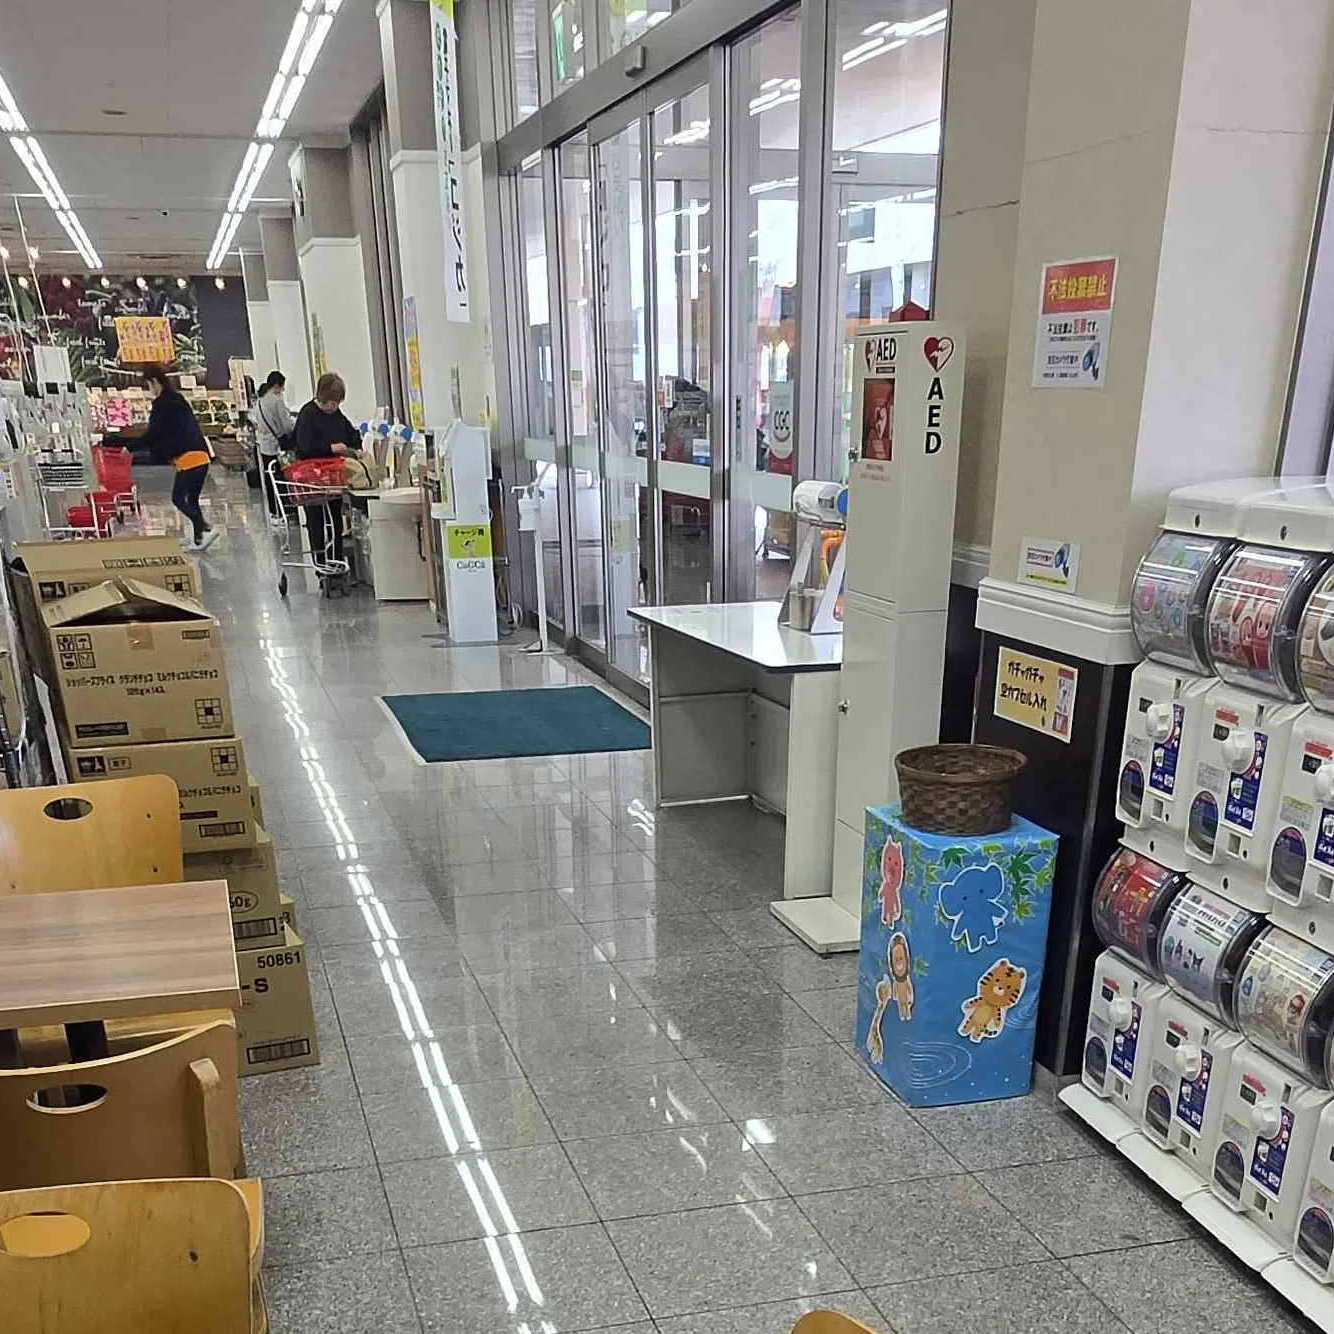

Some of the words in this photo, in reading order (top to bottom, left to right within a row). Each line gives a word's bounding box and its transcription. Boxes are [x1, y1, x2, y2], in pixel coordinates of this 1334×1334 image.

[876, 337, 897, 362] AED
[925, 377, 944, 455] AED
[257, 951, 301, 969] 50861
